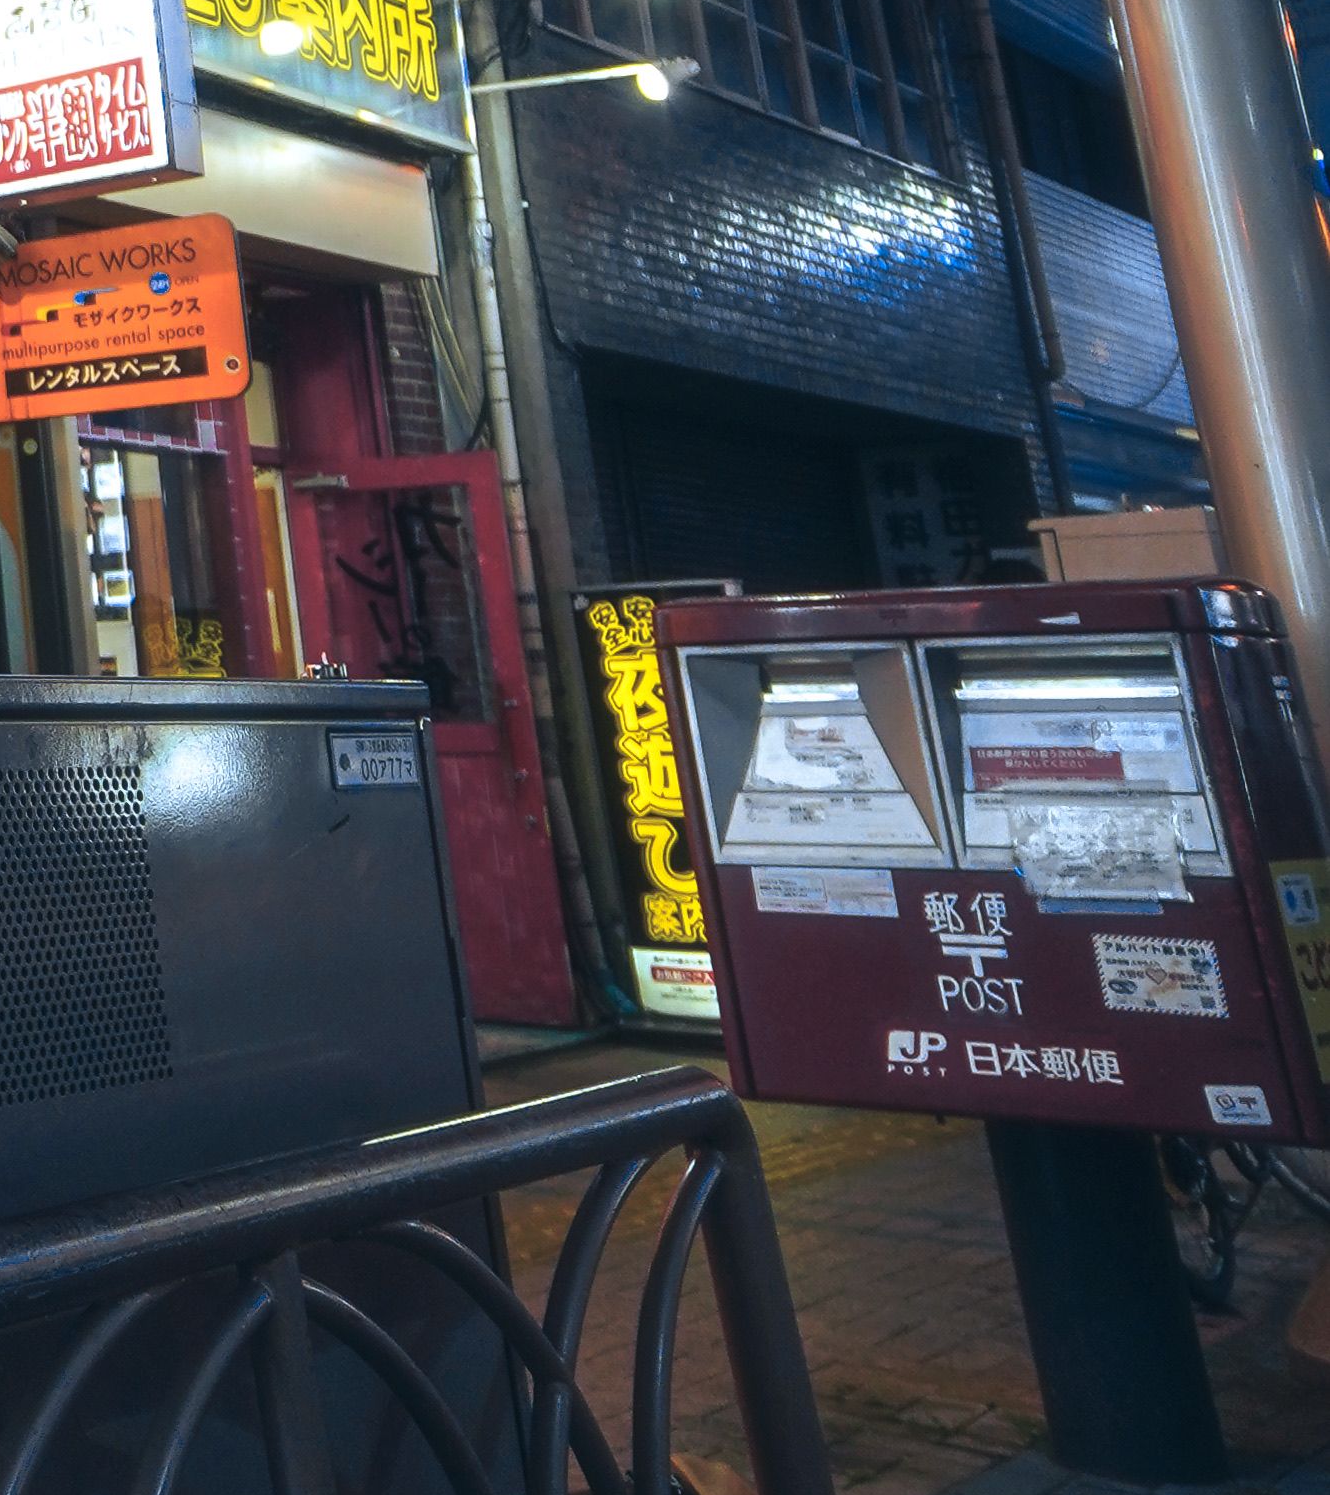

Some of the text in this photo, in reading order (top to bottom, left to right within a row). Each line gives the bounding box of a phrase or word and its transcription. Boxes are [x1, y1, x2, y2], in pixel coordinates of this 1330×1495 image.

[98, 238, 197, 274] WORKS
[1, 322, 206, 361] multipurpose rental space
[28, 353, 183, 393] レンタルスペース
[922, 890, 1014, 938] 郵便
[938, 974, 1024, 1017] POST
[886, 1064, 948, 1078] POST
[965, 1040, 1125, 1087] 日本郵便
